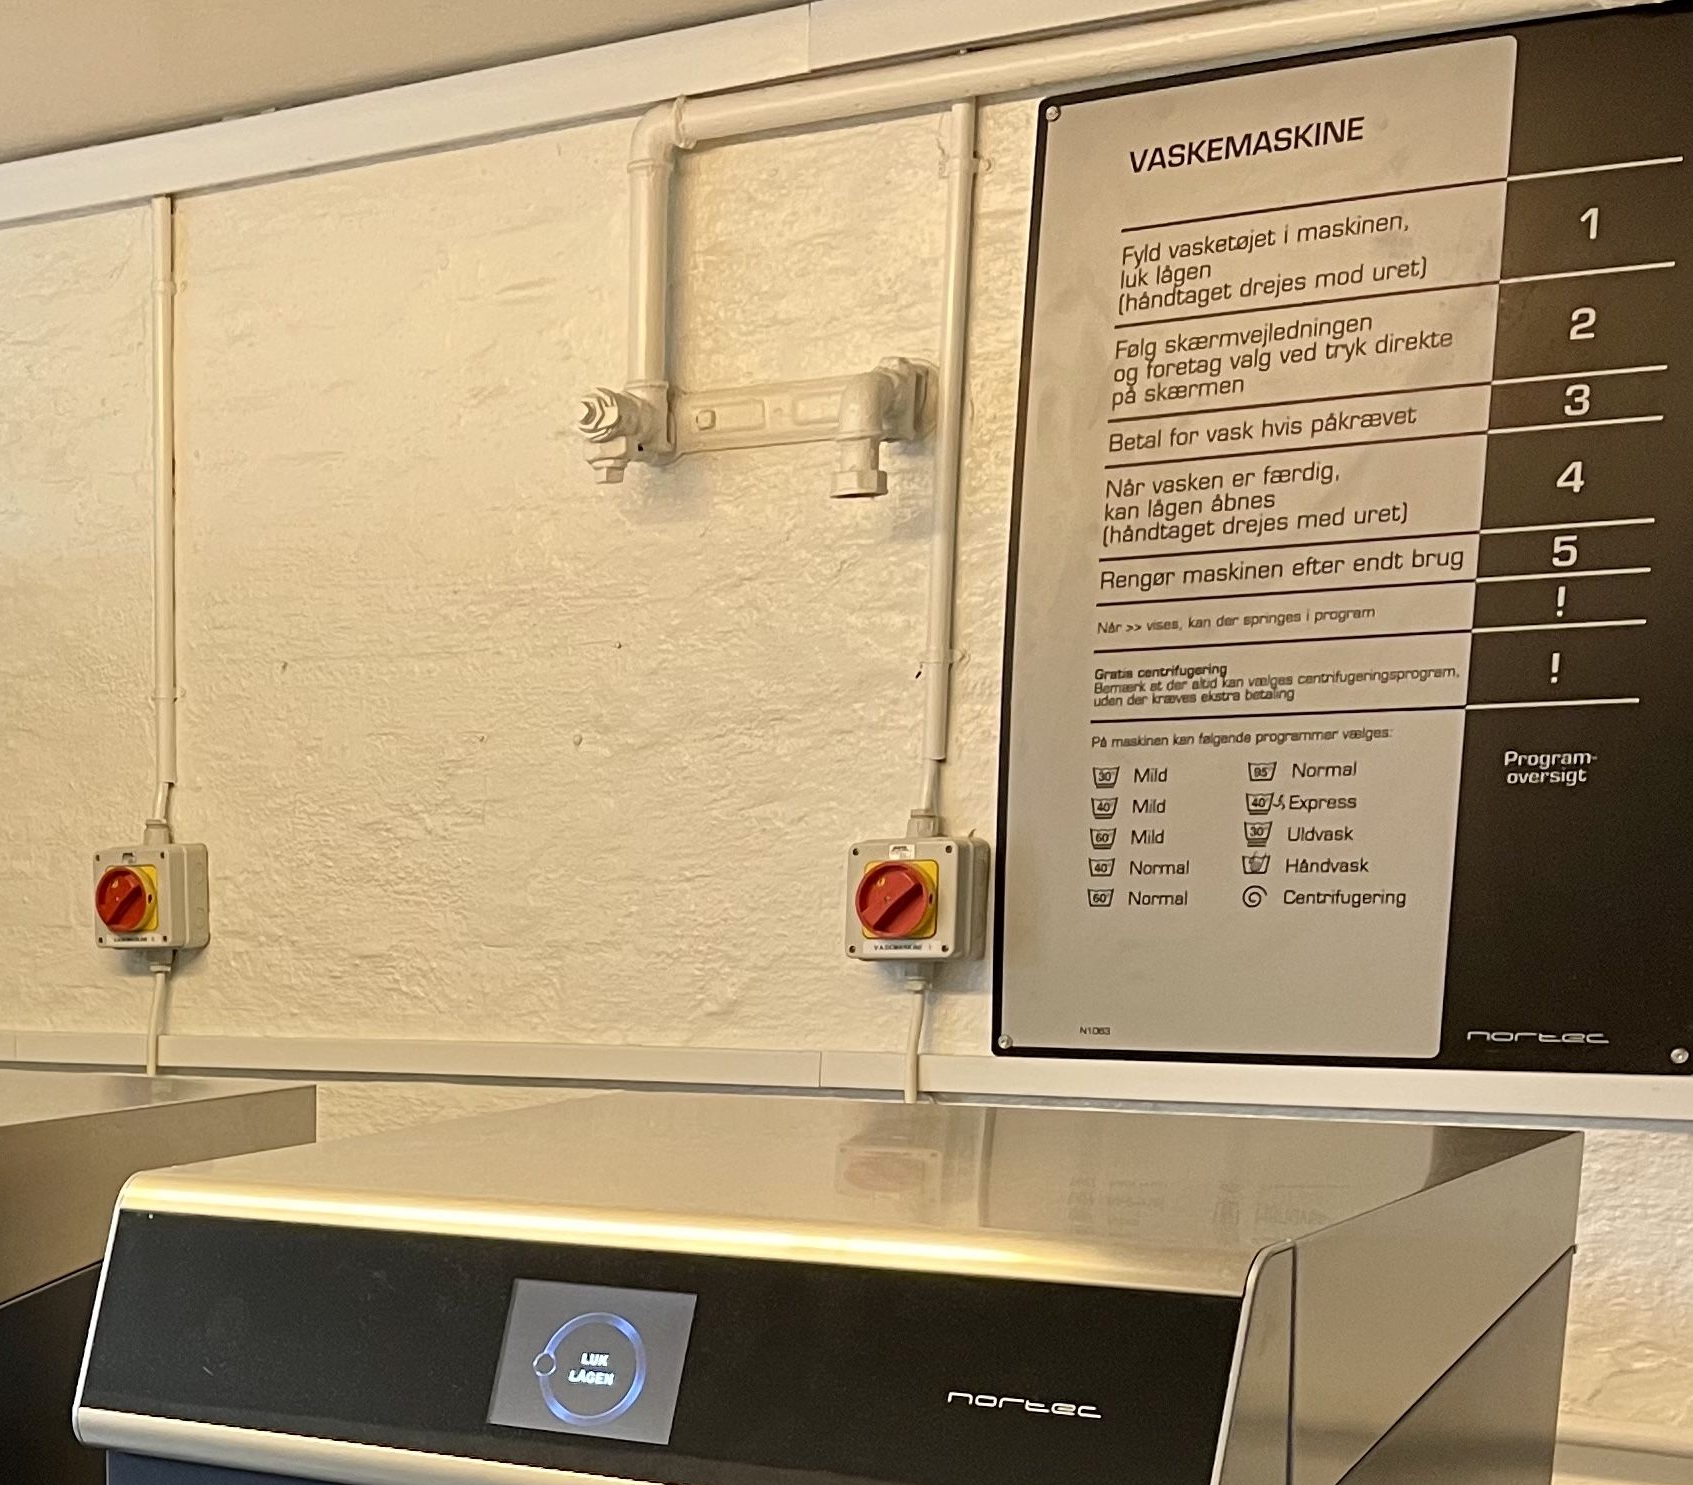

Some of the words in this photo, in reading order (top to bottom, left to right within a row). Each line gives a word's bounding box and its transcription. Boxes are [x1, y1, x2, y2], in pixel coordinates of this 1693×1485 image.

[1130, 116, 1365, 174] VASKEMASKINE
[1580, 207, 1599, 240] 1
[1122, 243, 1161, 269] Fyld
[1169, 229, 1276, 259] vasketøjet
[1284, 224, 1289, 245] i
[1297, 214, 1409, 243] maskinen,
[1118, 281, 1231, 316] (håndtaget
[1240, 273, 1306, 297] drejes
[1315, 264, 1363, 288] mod
[1372, 256, 1427, 281] uret)
[1120, 268, 1148, 289] luk
[1156, 264, 1211, 288] lågen
[1569, 307, 1597, 341] 2
[1115, 340, 1157, 361] Følg
[1165, 316, 1372, 354] skærmvejledningen
[1114, 367, 1138, 386] og
[1147, 355, 1221, 380] foretag
[1230, 347, 1271, 372] valg
[1280, 342, 1316, 364] ved
[1325, 337, 1367, 363] tryk
[1375, 330, 1453, 354] direkte
[1111, 385, 1136, 410] på
[1144, 378, 1244, 403] skærmen
[1563, 384, 1591, 416] 3
[1109, 430, 1162, 452] Betal
[1170, 428, 1199, 447] for
[1207, 421, 1253, 443] vask
[1261, 417, 1303, 439] hvis
[1311, 406, 1417, 438] påkrævet
[1106, 477, 1146, 498] Når
[1152, 471, 1223, 494] vasken
[1232, 471, 1255, 487] er
[1264, 461, 1340, 486] færdig,
[1556, 460, 1585, 493] 4
[1104, 502, 1139, 521] kan
[1147, 499, 1203, 521] lågen
[1211, 491, 1275, 513] åbnes
[1102, 519, 1216, 548] (håndtaget
[1222, 512, 1288, 537] drejes
[1297, 507, 1345, 529] med
[1354, 501, 1408, 525] uret)
[1551, 534, 1578, 567] 5
[1100, 569, 1175, 591] Rengør
[1183, 560, 1283, 585] maskinen
[1292, 556, 1345, 578] efter
[1353, 551, 1404, 573] endt
[1411, 548, 1464, 572] brug
[1097, 622, 1122, 634] Når
[1188, 616, 1211, 628] kan
[1216, 615, 1239, 627] der
[1243, 612, 1301, 627] springes
[1314, 608, 1375, 624] program
[1093, 681, 1146, 694] Bemærk
[1150, 681, 1163, 691] at
[1166, 679, 1188, 691] der
[1192, 677, 1217, 690] altid
[1222, 676, 1244, 688] kan
[1248, 674, 1293, 689] vælges
[1094, 668, 1133, 680] Gratis
[1137, 663, 1228, 679] centrifugering
[1093, 695, 1123, 707] uden
[1127, 694, 1148, 706] der
[1152, 692, 1197, 704] kræves
[1201, 691, 1240, 702] ekstra
[1245, 688, 1295, 702] betaling
[1091, 735, 1107, 748] På
[1111, 734, 1169, 748] maskinen
[1172, 733, 1194, 746] kan
[1198, 731, 1251, 747] følgende
[1255, 729, 1338, 746] programmer
[1292, 760, 1357, 779] Normal
[1504, 749, 1598, 772] Program-
[1133, 767, 1168, 783] Mild
[1506, 767, 1587, 787] oversigt
[1132, 798, 1167, 814] Mild
[1288, 794, 1357, 813] Express
[1130, 828, 1165, 845] Mild
[1287, 825, 1354, 842] Uldvask
[1129, 859, 1190, 875] Normal
[1285, 856, 1369, 874] Håndvask
[1128, 890, 1188, 906] Normal
[1283, 888, 1407, 908] Centrifugering
[1467, 1030, 1610, 1044] nortec
[580, 1352, 610, 1368] LUK
[947, 1391, 1102, 1419] nortec
